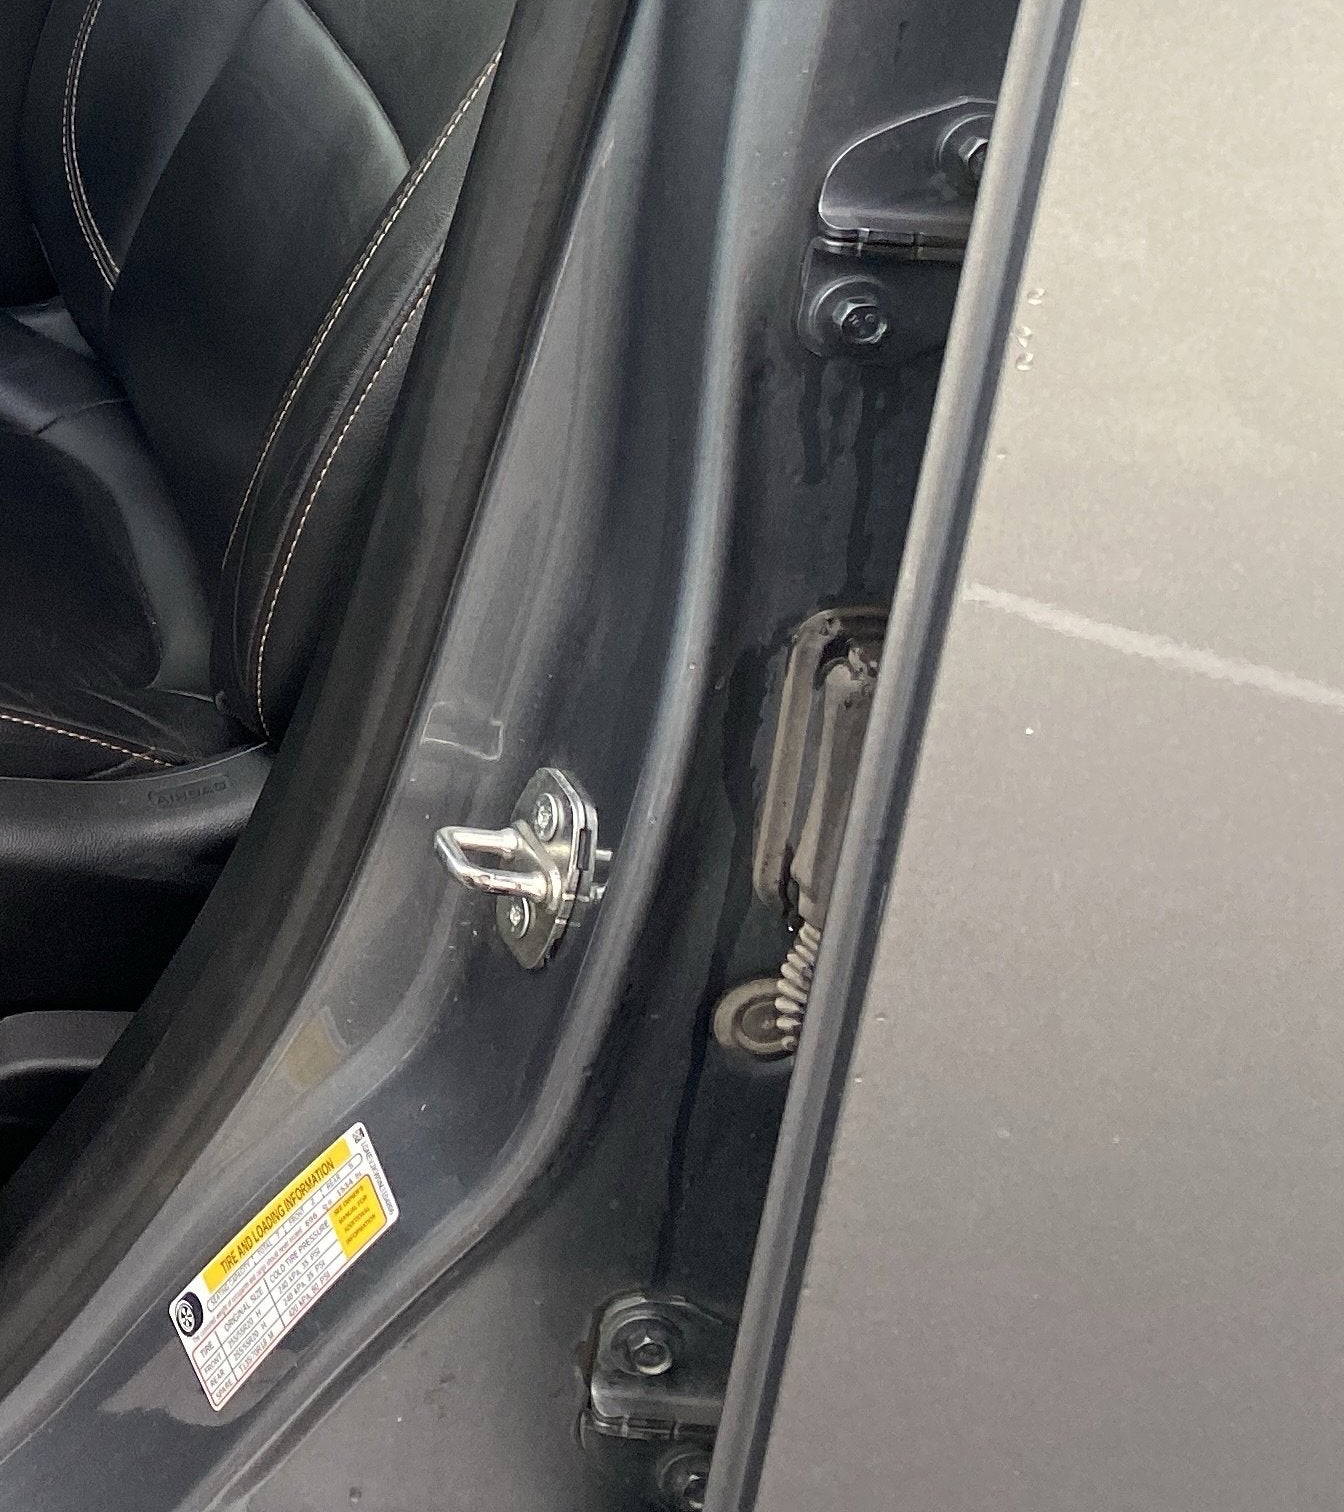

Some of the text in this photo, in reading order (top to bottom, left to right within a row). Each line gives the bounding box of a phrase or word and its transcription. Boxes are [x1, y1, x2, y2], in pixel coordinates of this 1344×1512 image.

[325, 1171, 341, 1191] REAR
[219, 1249, 239, 1274] TIRE
[235, 1233, 254, 1258] AND
[251, 1202, 286, 1243] LOADING
[282, 1155, 335, 1213] INFORMATION
[199, 1218, 329, 1359] TIRE ORIGINAL SIZE COLD TIRE PRESSURE
[202, 1351, 223, 1376] FRONT
[208, 1367, 225, 1388] REAR
[214, 1376, 233, 1400] SPARE
